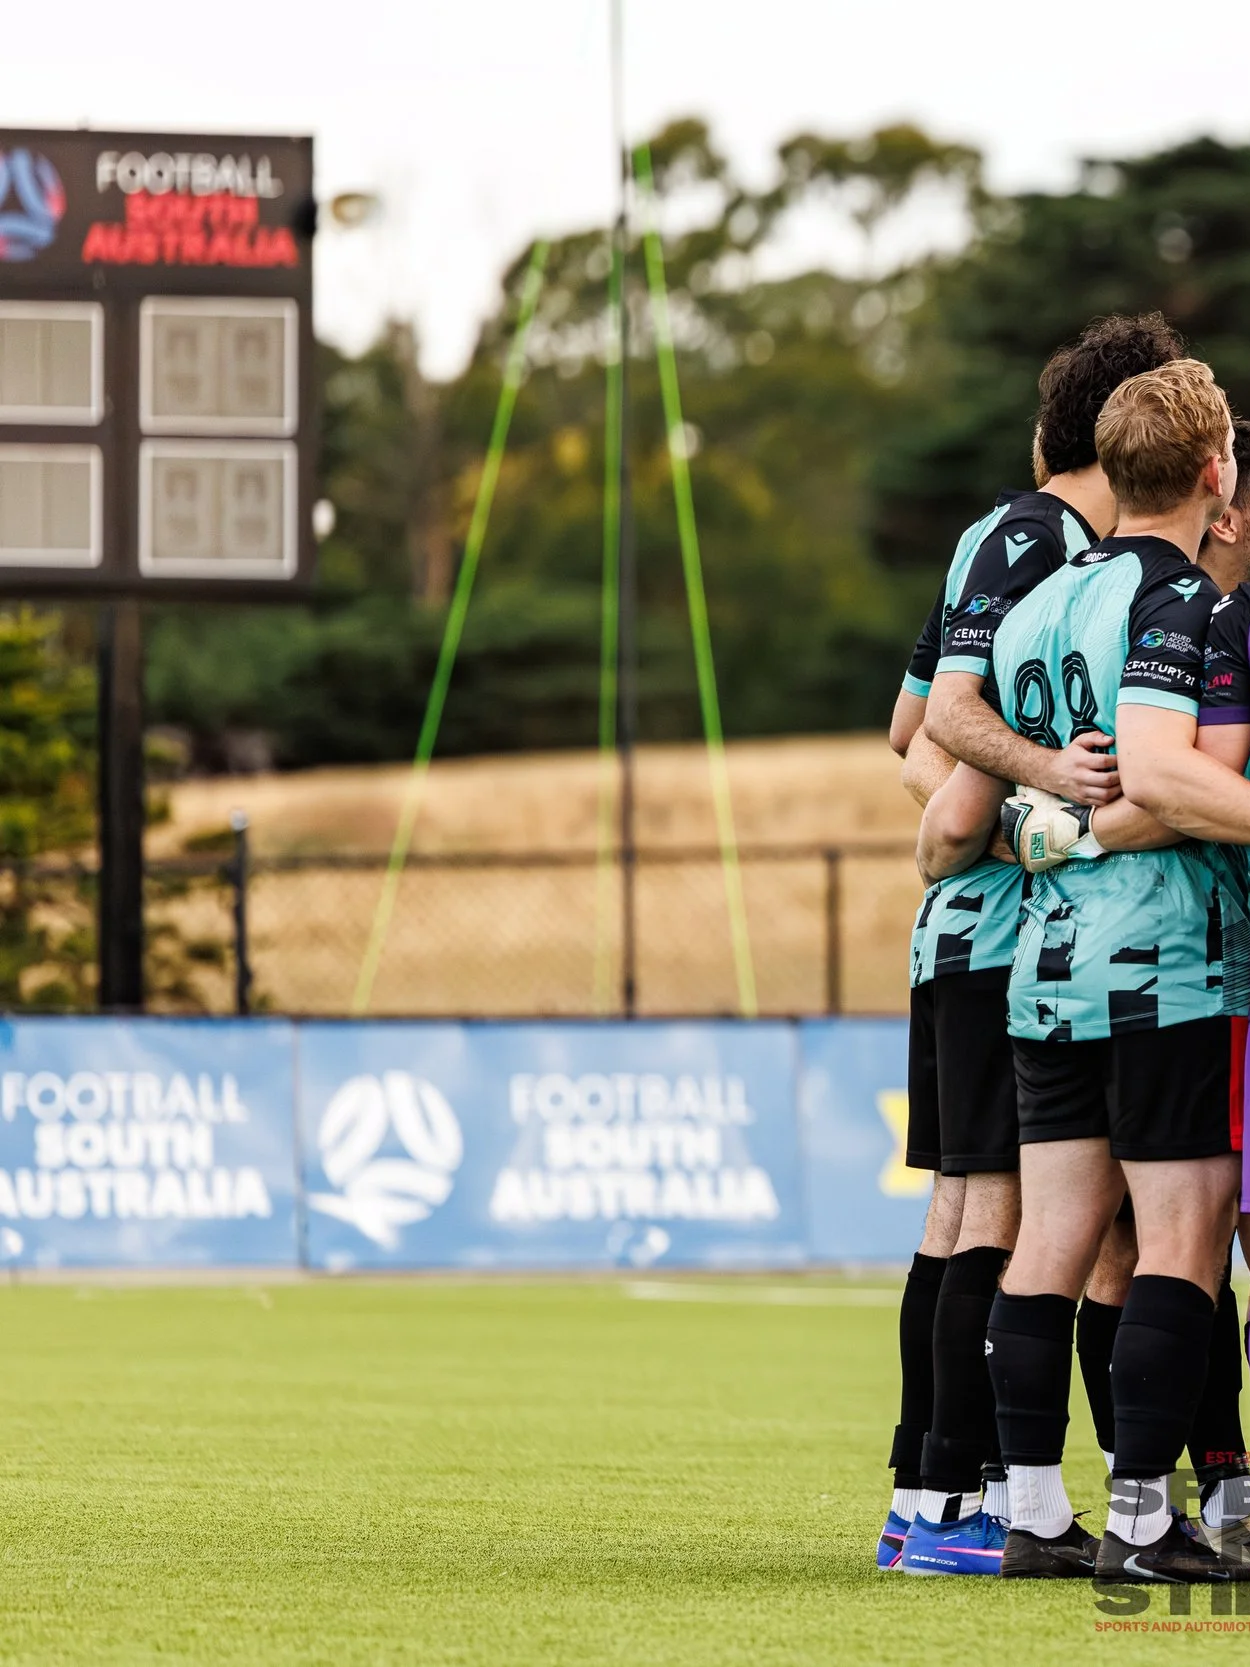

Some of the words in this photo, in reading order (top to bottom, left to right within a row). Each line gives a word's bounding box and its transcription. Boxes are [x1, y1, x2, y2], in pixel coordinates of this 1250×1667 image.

[96, 151, 284, 199] FOOTBALL
[81, 222, 298, 268] AUSTRALIA
[1169, 632, 1192, 643] ALLIED
[1125, 660, 1186, 680] CENTURY
[1184, 674, 1196, 687] 21
[1143, 671, 1172, 683] Brighton
[2, 1071, 249, 1123] FOOTBALL
[509, 1072, 756, 1126] FOOTBALL
[34, 1120, 214, 1169] SOUTH
[543, 1122, 722, 1170] SOUTH
[489, 1166, 781, 1222] AUSTRALIA
